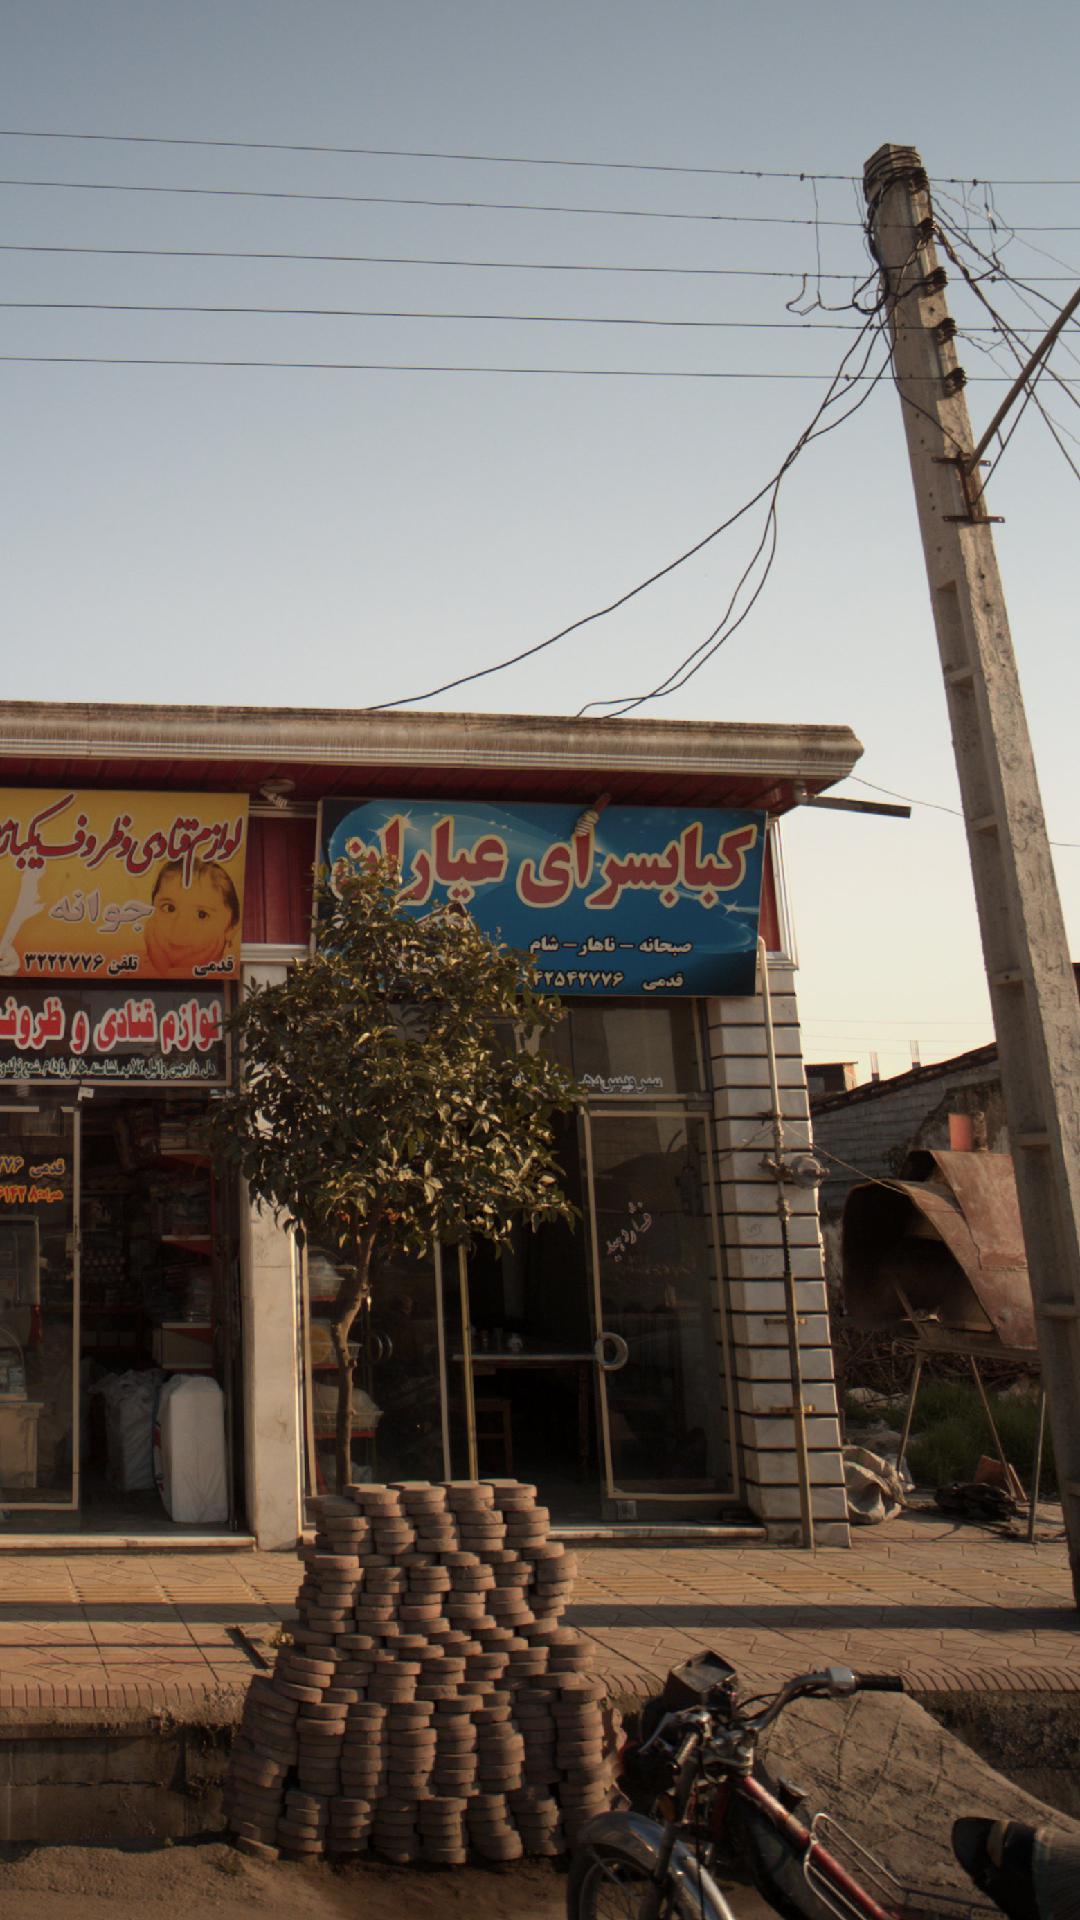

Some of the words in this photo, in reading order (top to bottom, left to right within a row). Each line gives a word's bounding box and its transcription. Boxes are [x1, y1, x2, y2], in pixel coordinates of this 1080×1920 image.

[114, 834, 132, 859] و
[125, 815, 200, 875] قنادی
[185, 815, 243, 889] لوازم
[50, 890, 155, 933] جوانه
[528, 934, 560, 954] شام
[577, 936, 617, 957] ناهار
[638, 936, 693, 956] صبحانه
[107, 954, 138, 976] تلفن
[193, 956, 235, 976] قدمی
[641, 972, 685, 991] قدمی
[69, 1009, 90, 1054] و
[93, 998, 158, 1052] قنادی
[160, 998, 223, 1054] لوازم
